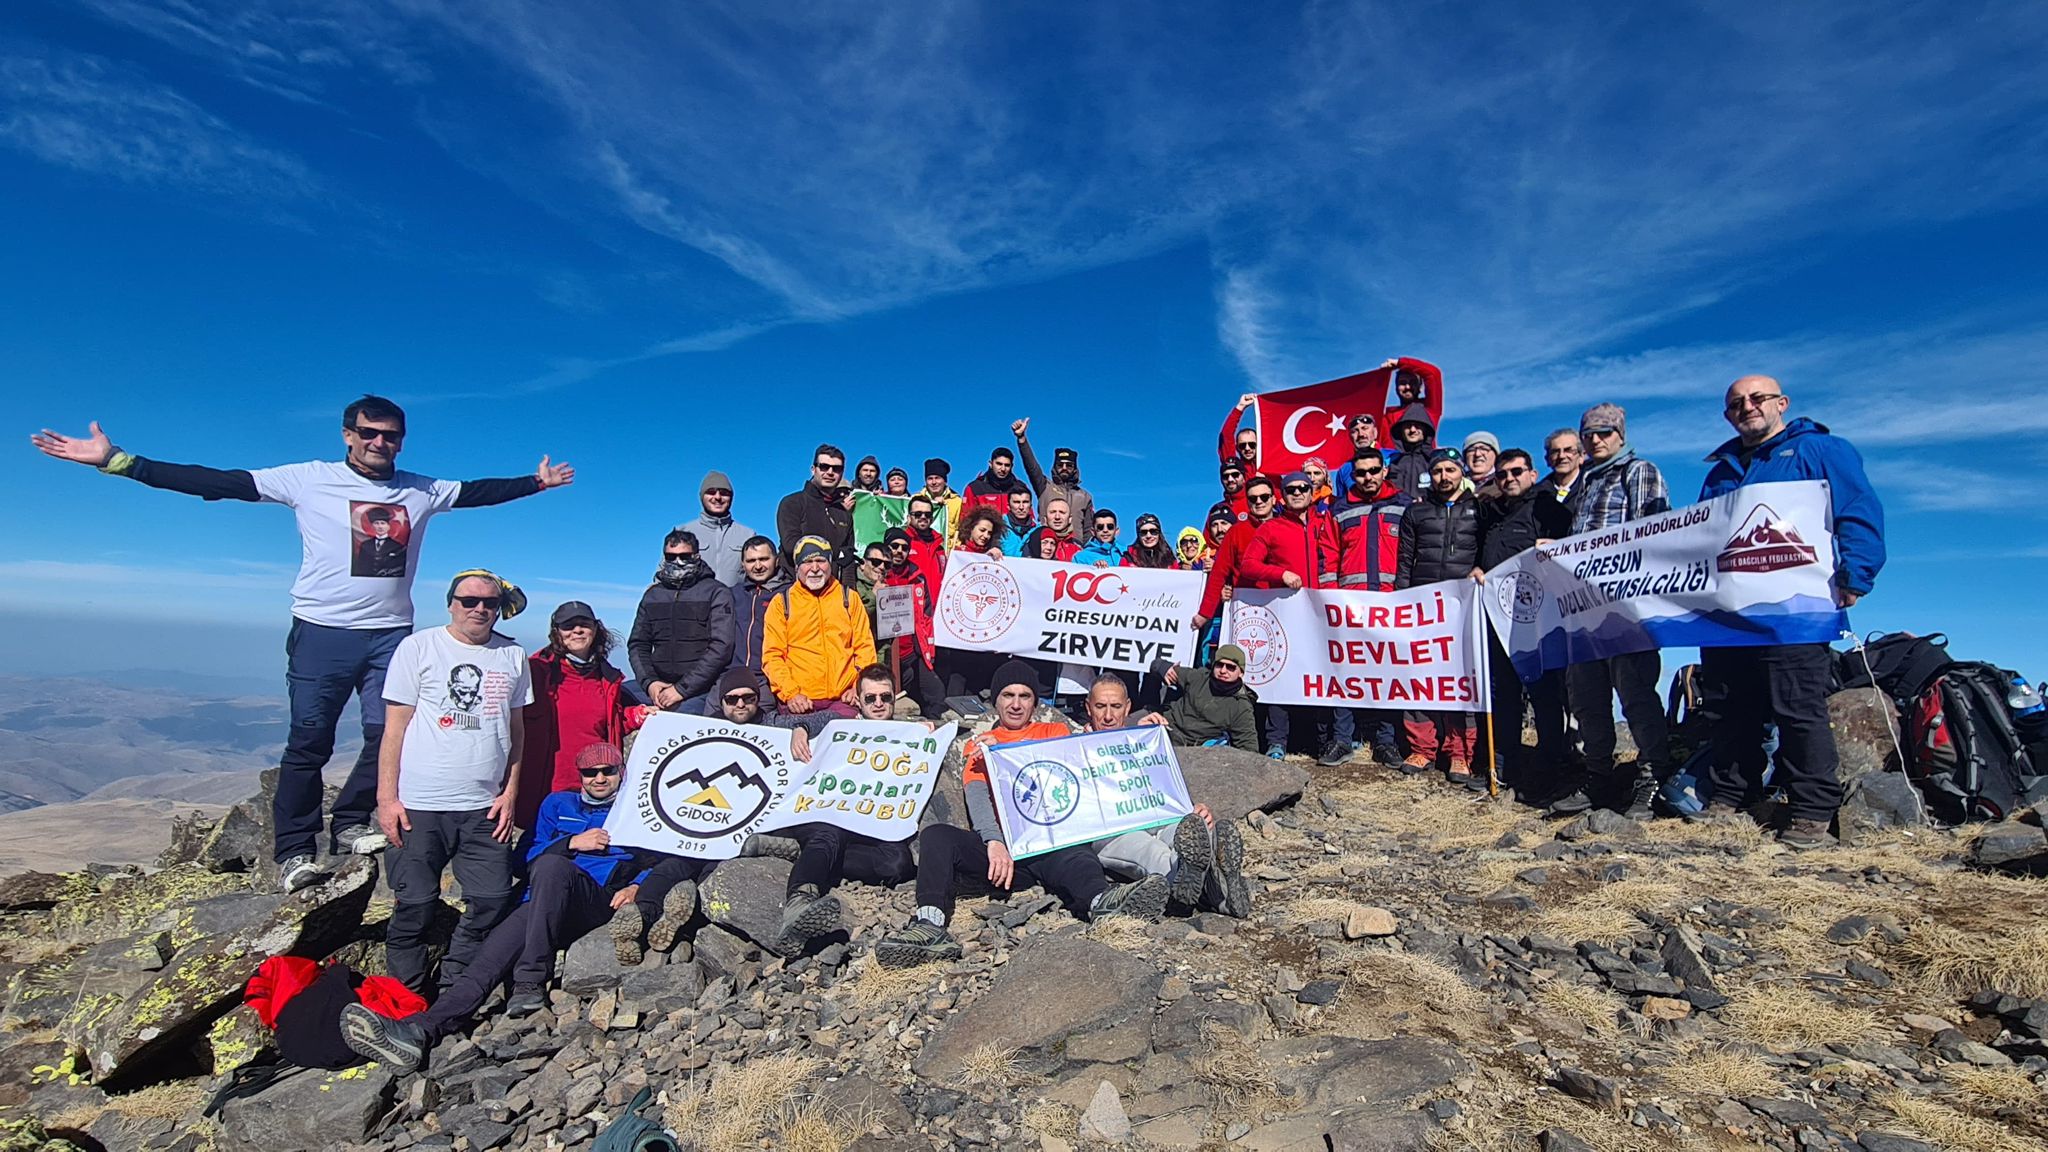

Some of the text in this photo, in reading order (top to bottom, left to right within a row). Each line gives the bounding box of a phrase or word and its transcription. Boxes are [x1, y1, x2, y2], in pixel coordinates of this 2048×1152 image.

[1536, 507, 1711, 563] GNÇLİK VE SPOR İL MÜDÜRLÜĞÜ
[1574, 549, 1642, 581] GİRESUN
[1599, 559, 1709, 604] TEMSİLCİLİĞİ
[1325, 591, 1445, 628] DERELİ
[1328, 636, 1454, 665] DEVLET
[1303, 669, 1479, 703] HASTANESİ
[649, 734, 691, 765] DOĞA
[696, 728, 774, 751] SPORLARI
[771, 752, 789, 787] SPOR
[847, 748, 929, 776] DOĞA
[1118, 775, 1152, 792] SPOR
[638, 771, 663, 832] GİRESUN
[794, 794, 917, 820] KULÜBÜ
[1115, 790, 1166, 816] KULÜBÜ
[677, 840, 706, 852] 2019
